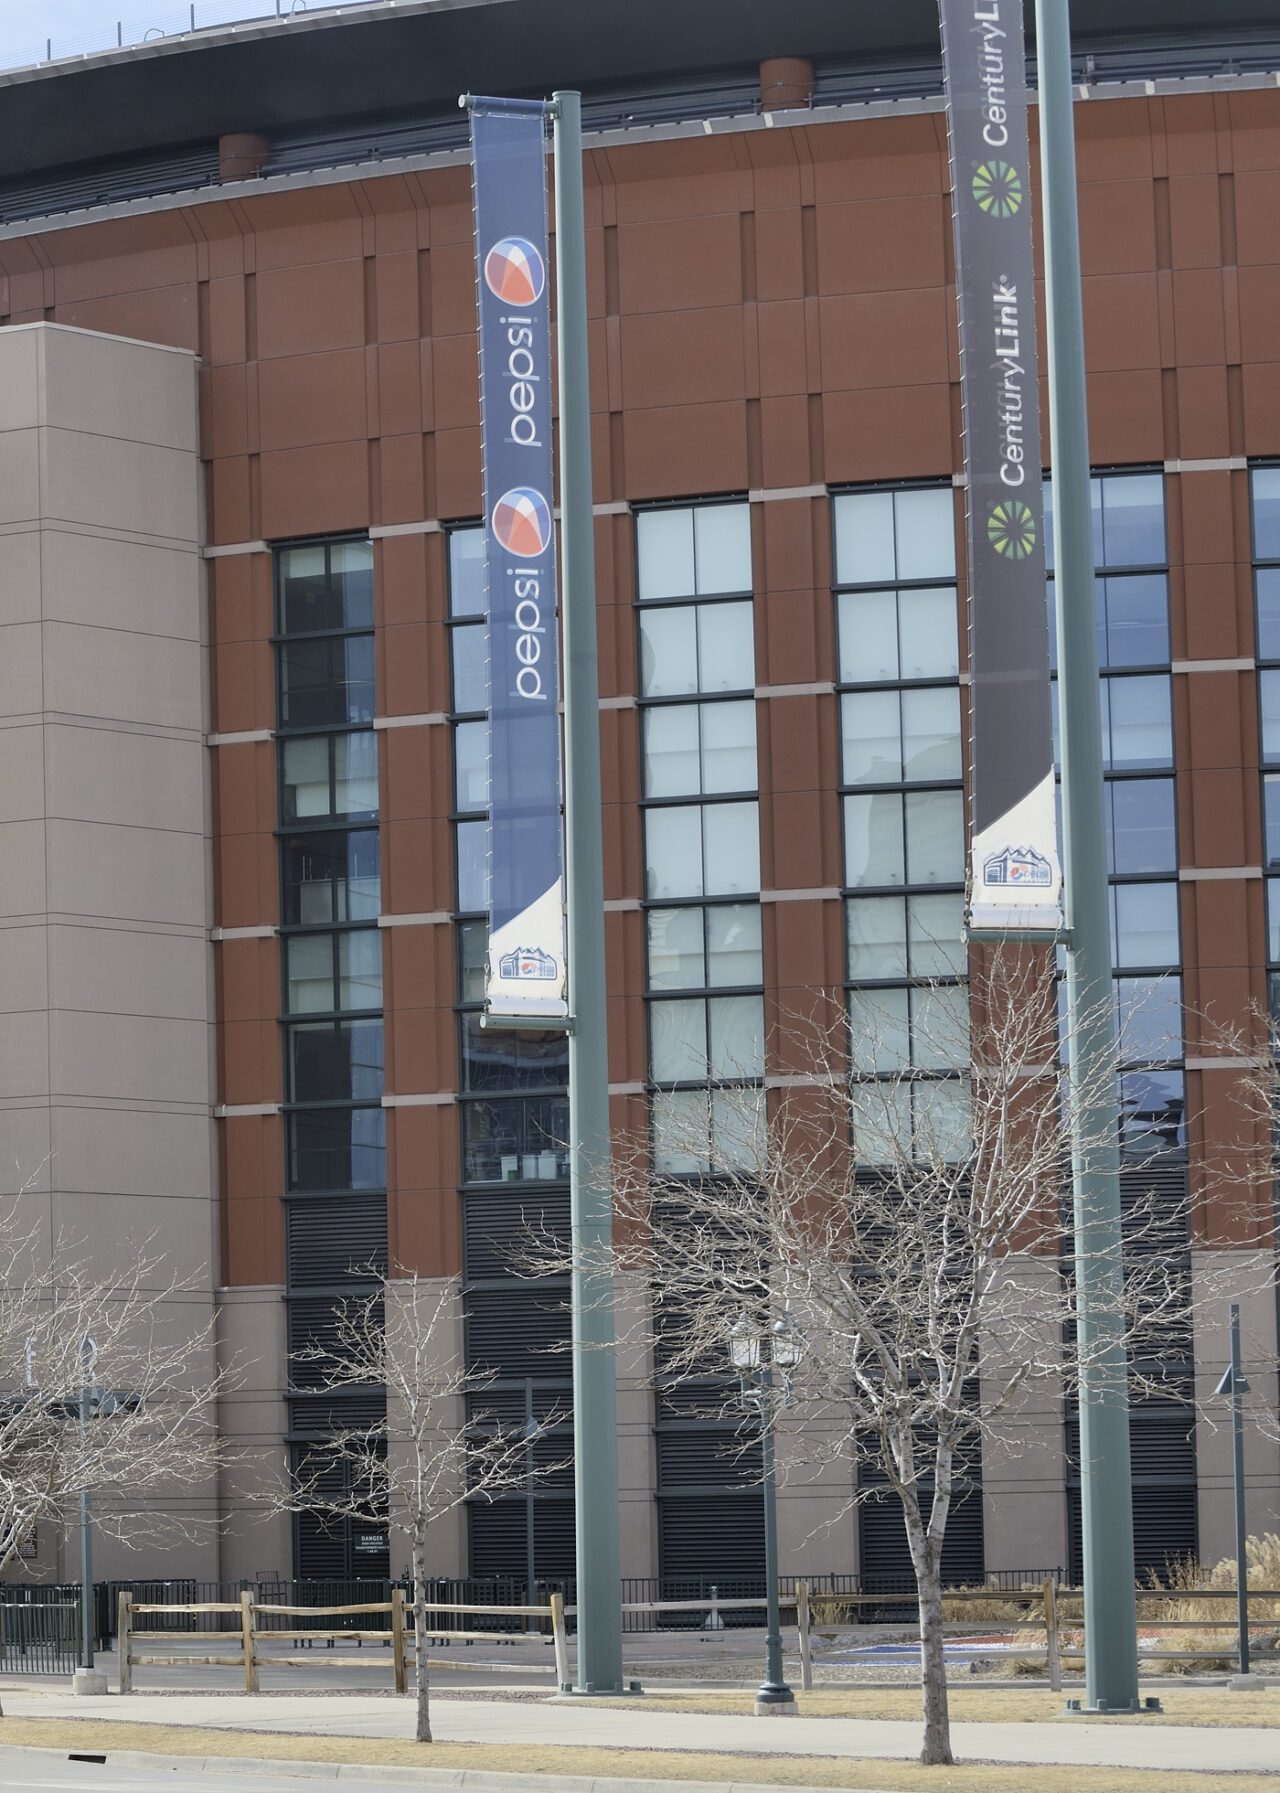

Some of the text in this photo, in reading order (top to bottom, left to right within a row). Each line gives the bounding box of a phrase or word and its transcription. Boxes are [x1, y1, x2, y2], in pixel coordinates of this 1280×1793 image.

[974, 0, 1008, 147] CenturyL
[500, 316, 542, 447] pepsi
[506, 567, 547, 700] pepsi
